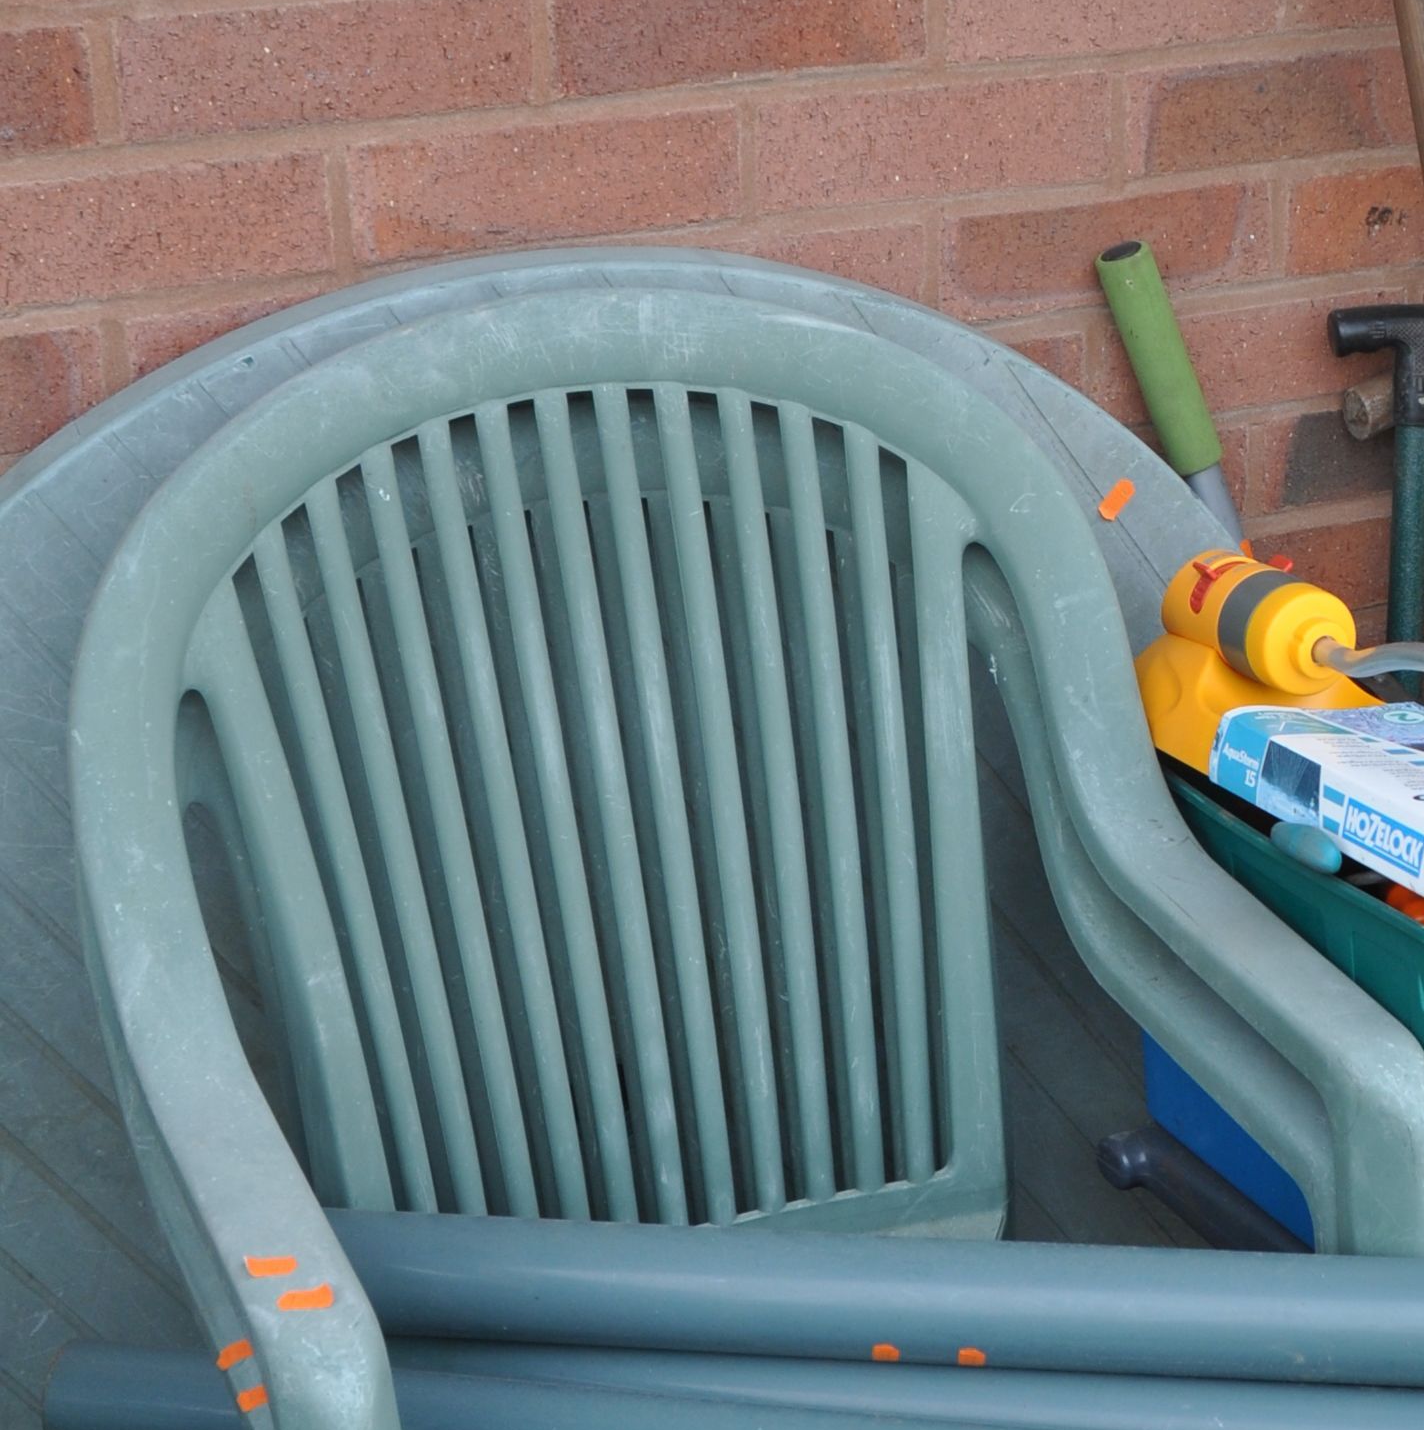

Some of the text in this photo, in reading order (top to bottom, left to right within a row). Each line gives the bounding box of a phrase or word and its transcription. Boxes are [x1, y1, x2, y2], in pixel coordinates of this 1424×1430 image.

[1222, 743, 1260, 770] AquaStorm
[1244, 768, 1257, 787] 15
[1347, 805, 1423, 868] HOZELOCK
